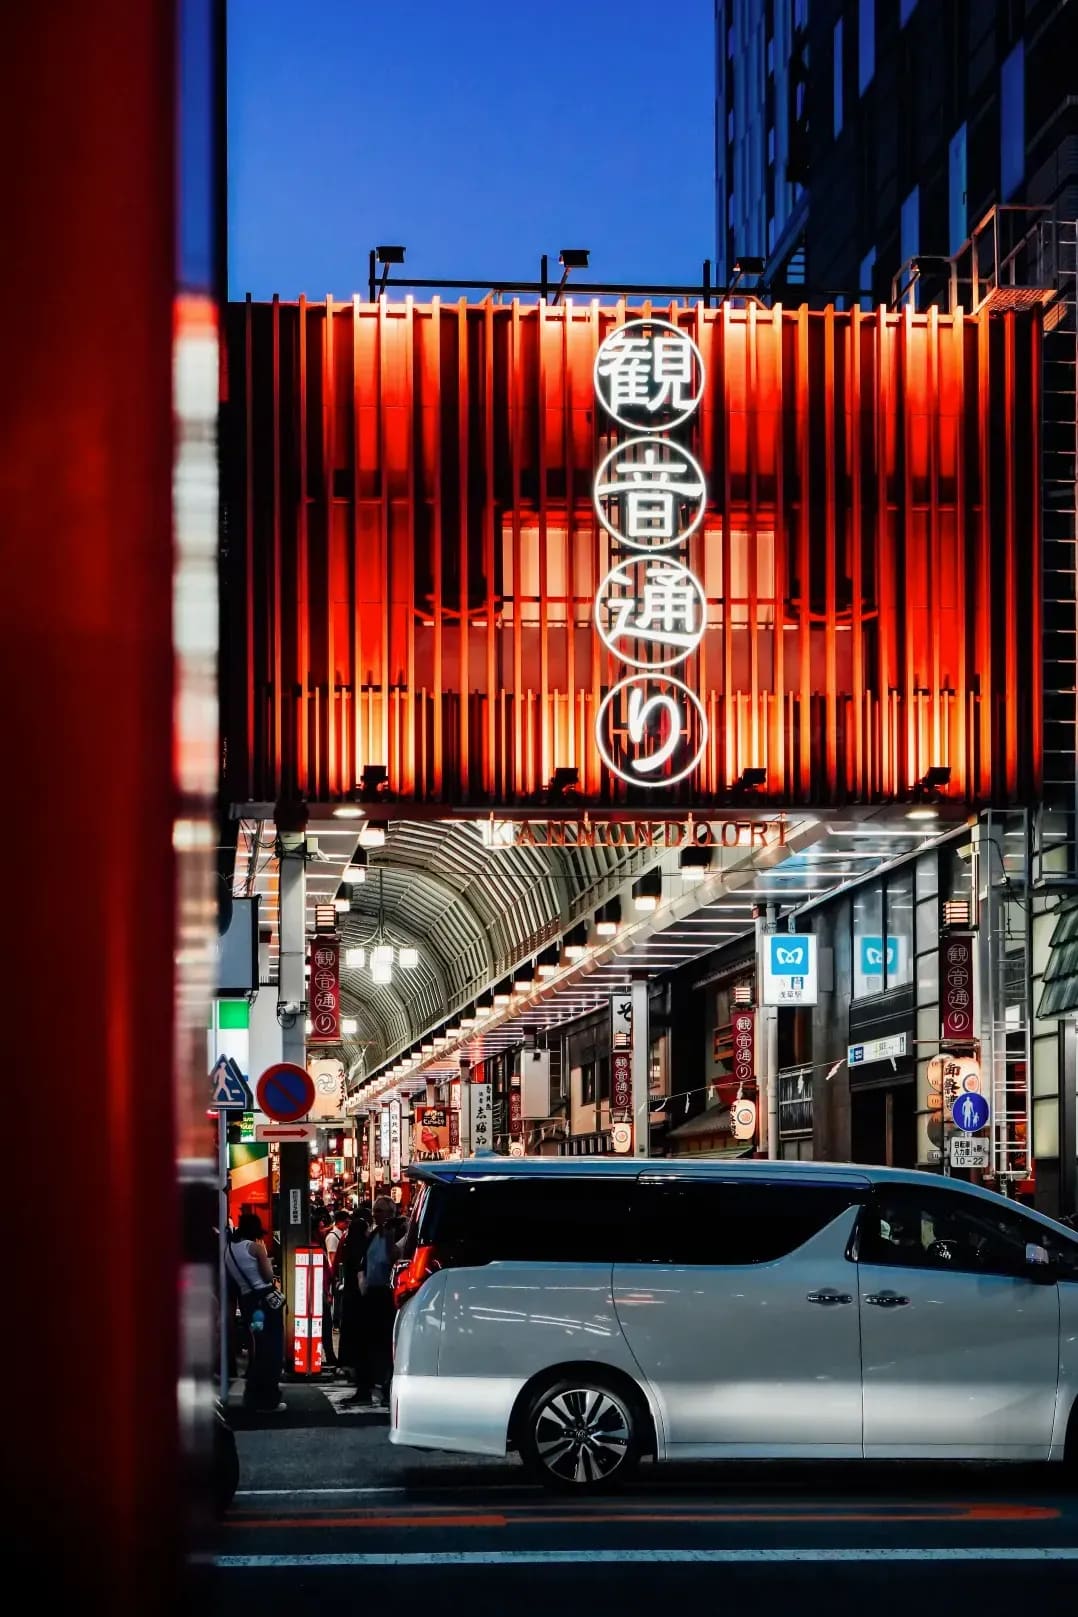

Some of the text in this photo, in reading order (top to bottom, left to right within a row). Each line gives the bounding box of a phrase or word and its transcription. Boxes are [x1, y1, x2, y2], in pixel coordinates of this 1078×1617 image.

[597, 327, 704, 776] 観音通り
[489, 819, 787, 848] KANNONDOORI
[315, 949, 336, 1033] 観音通り
[948, 944, 969, 1031] 観音通り
[737, 1017, 752, 1080] 観音通り
[615, 1057, 628, 1106] 観音通り
[954, 1141, 970, 1149] 自転車
[955, 1157, 984, 1166] 10-22
